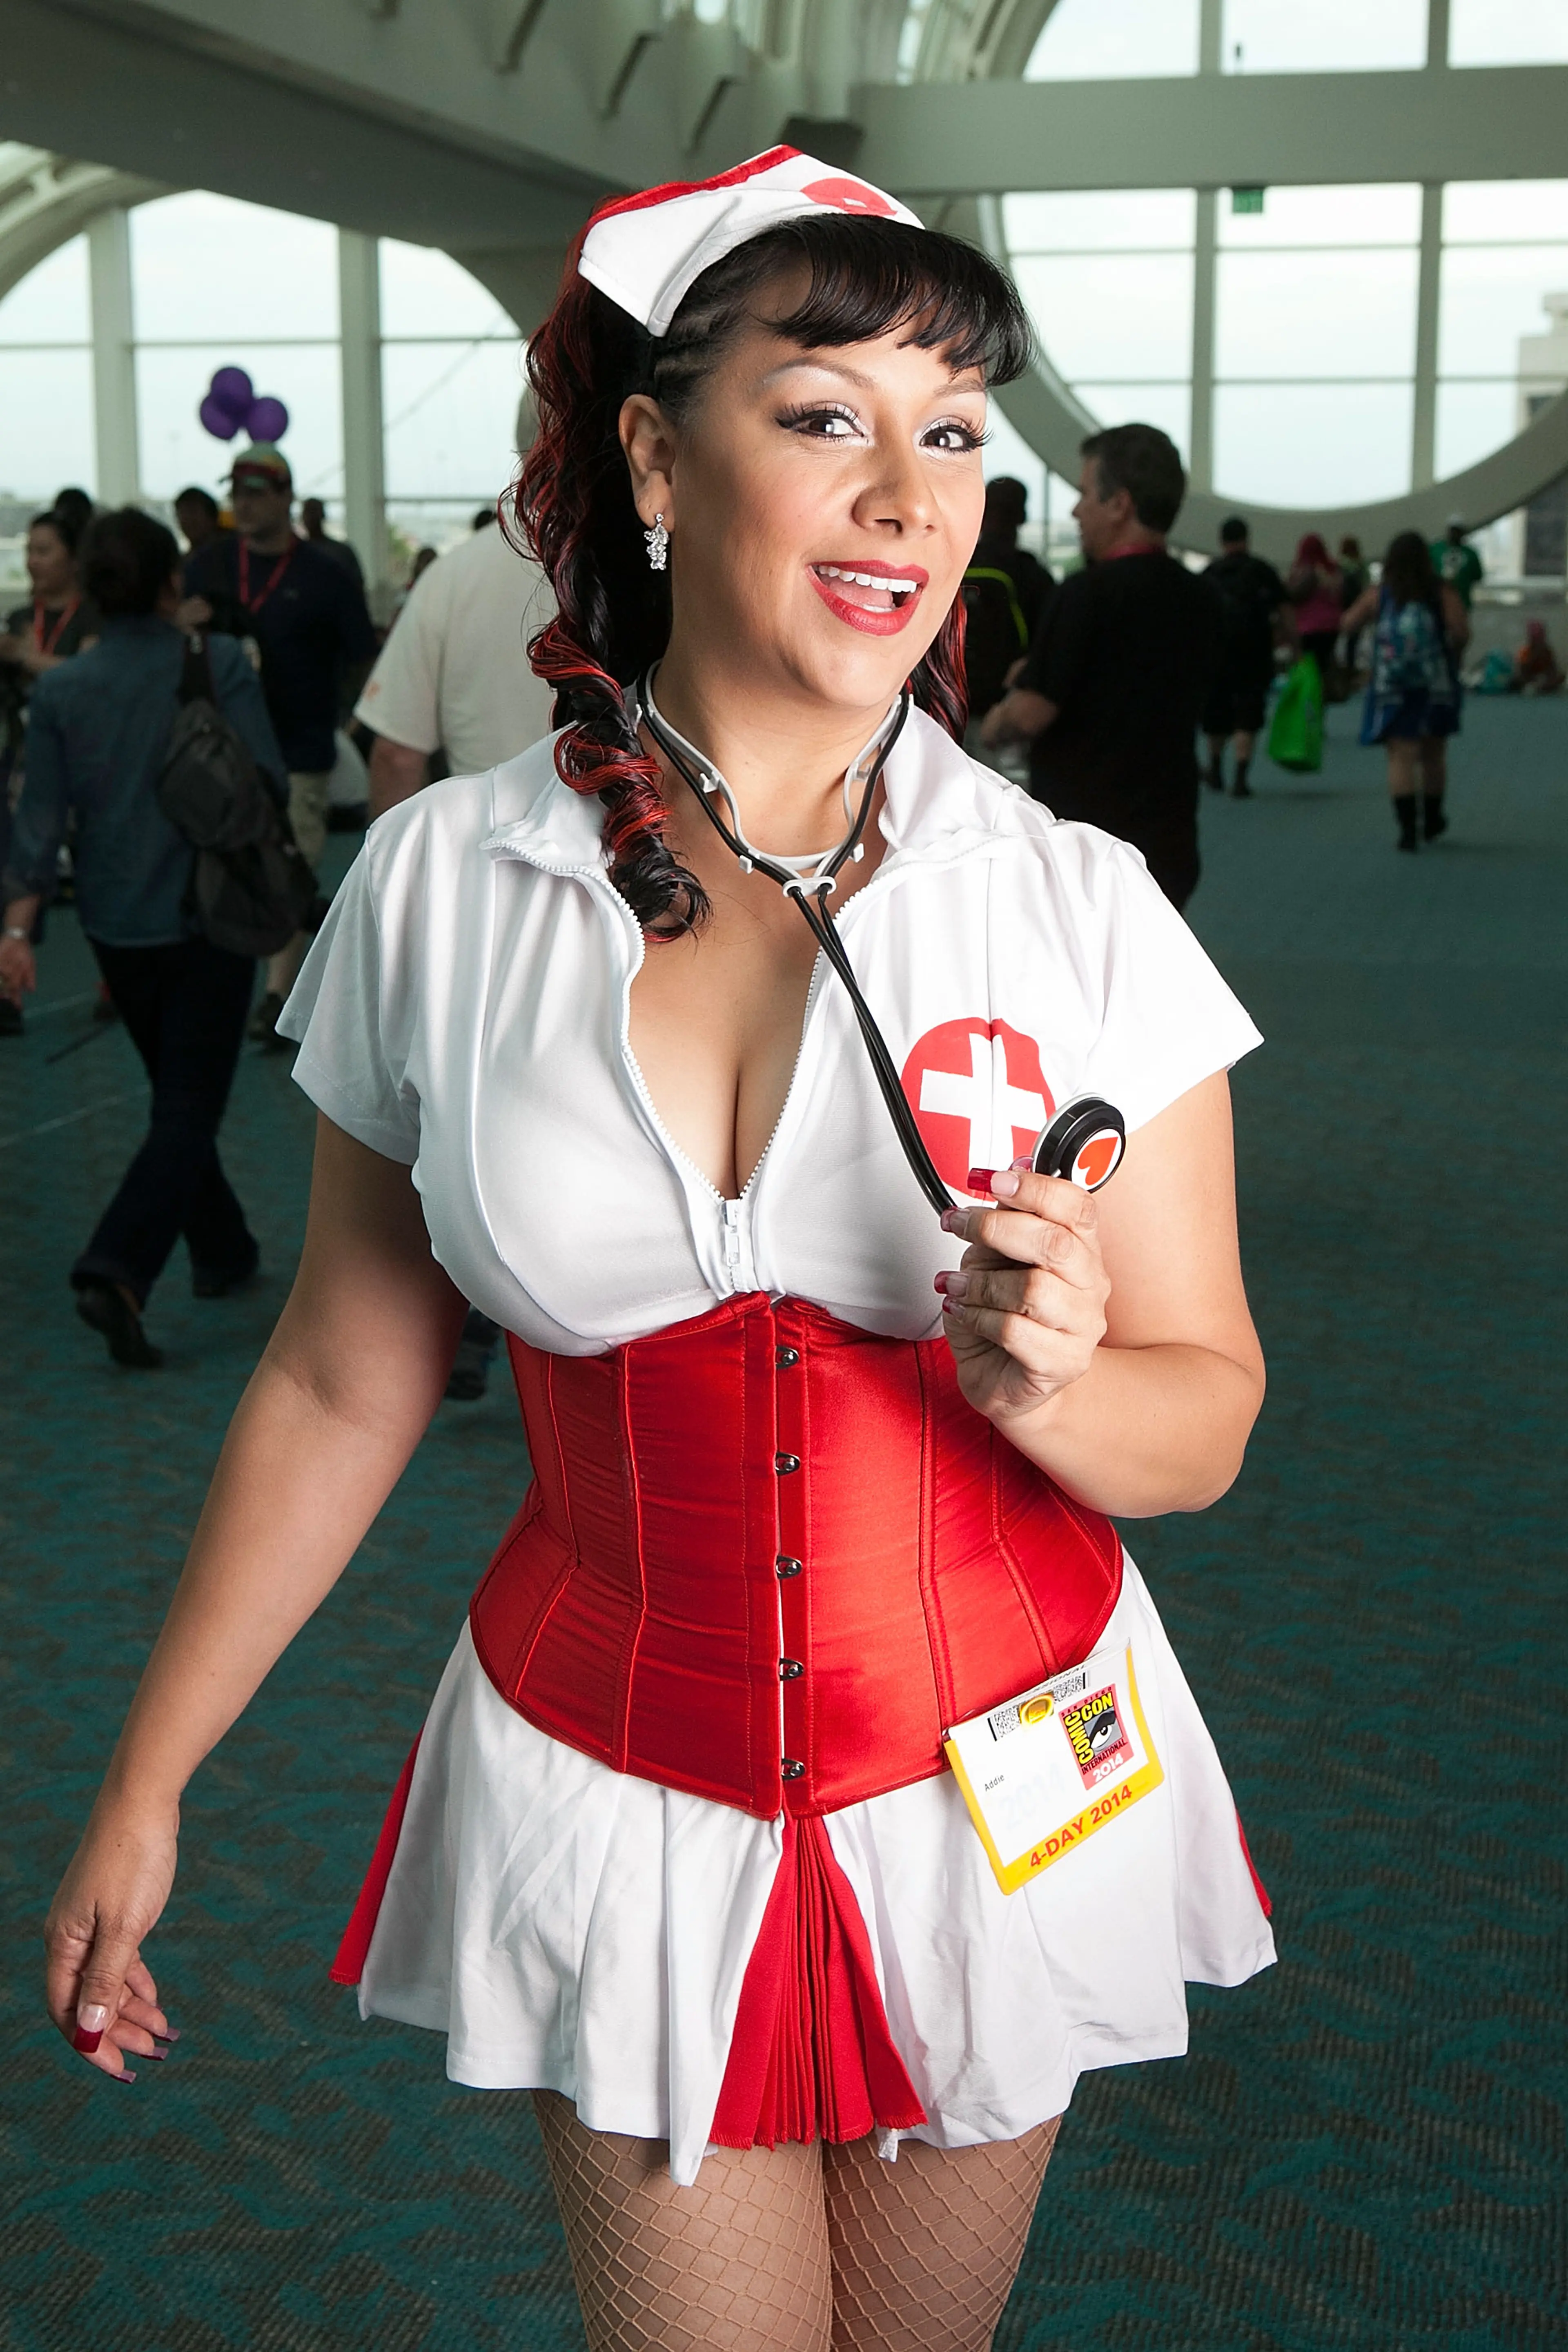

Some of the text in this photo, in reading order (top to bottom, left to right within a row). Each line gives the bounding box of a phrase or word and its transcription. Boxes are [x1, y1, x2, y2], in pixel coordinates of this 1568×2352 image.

[1061, 1687, 1111, 1717] SAN DIEGO
[1065, 1692, 1114, 1764] COMIC CON
[1081, 1738, 1128, 1775] INTERNATIONAL
[1093, 1752, 1123, 1783] 2014
[984, 1775, 1005, 1792] Addie
[1030, 1784, 1132, 1867] 4-DAY 2014
